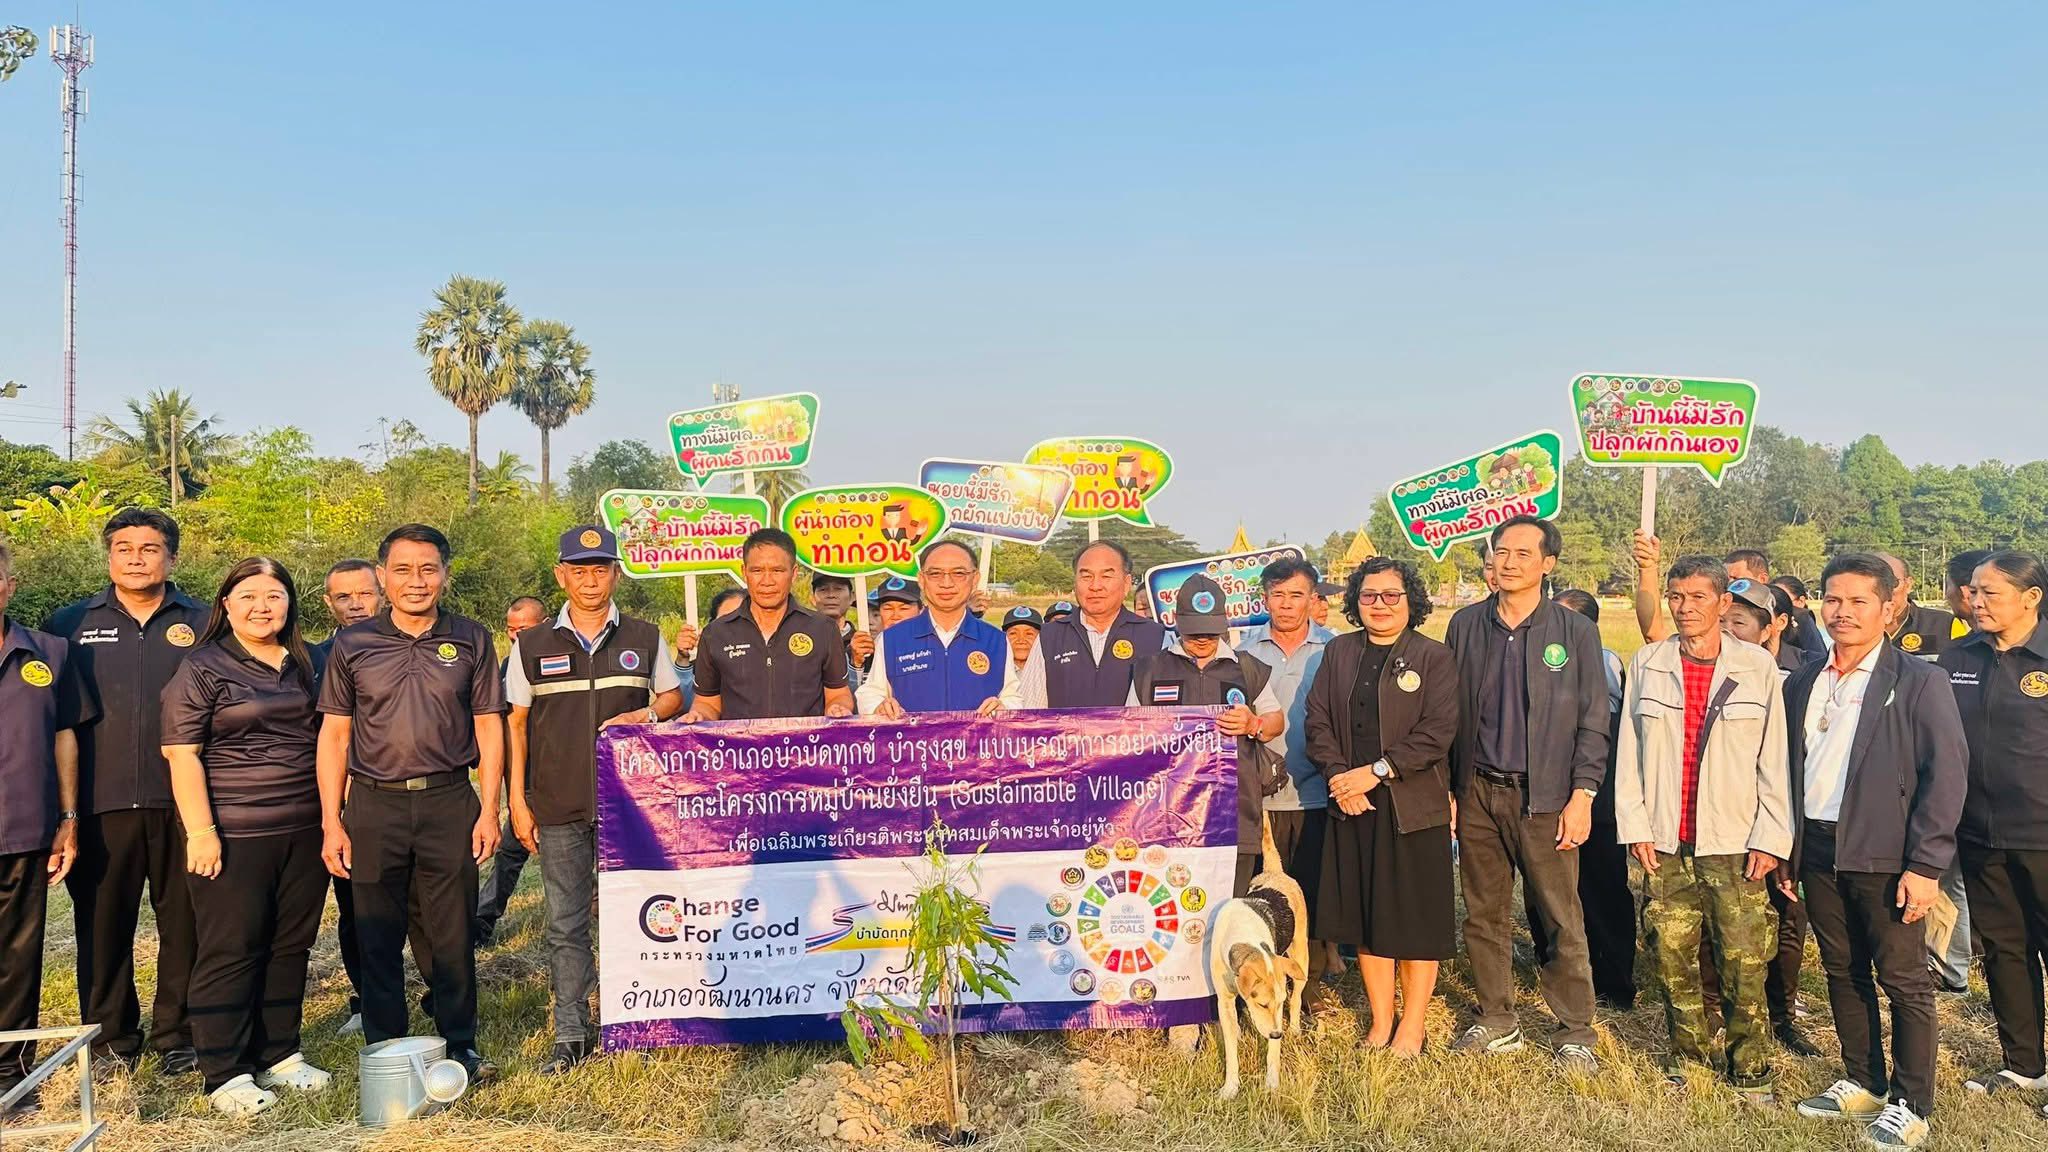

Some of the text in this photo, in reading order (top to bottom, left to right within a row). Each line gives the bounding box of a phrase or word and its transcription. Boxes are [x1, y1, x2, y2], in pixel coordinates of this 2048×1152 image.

[1632, 396, 1744, 425] บ้านนี้มีรัก
[1591, 430, 1739, 458] ปลูกผักกินเอง
[691, 442, 790, 475] ผู้คนรักกัน
[666, 512, 760, 537] บ้านนี้มีรัก
[794, 509, 874, 536] ผู้นำต้อง
[1424, 496, 1537, 546] ผู้คนรักกัน
[630, 542, 743, 568] ปลูกผักกินเอ
[812, 533, 912, 564] ทำก่อน
[618, 718, 1222, 776] โครงการอำเภอบำบัดทุกข์ บำรุงสุข แบบบูรณาการอย่างยั่งยืน
[676, 767, 1167, 821] และโครงการหมู่บ้านยั่งยืน (Sustainable Village)
[684, 916, 799, 943] For Good
[1110, 925, 1145, 934] GOALS
[640, 944, 797, 961] กระทรวงมหาดไทย
[623, 964, 816, 1010] อำเภอวัฒนานคร
